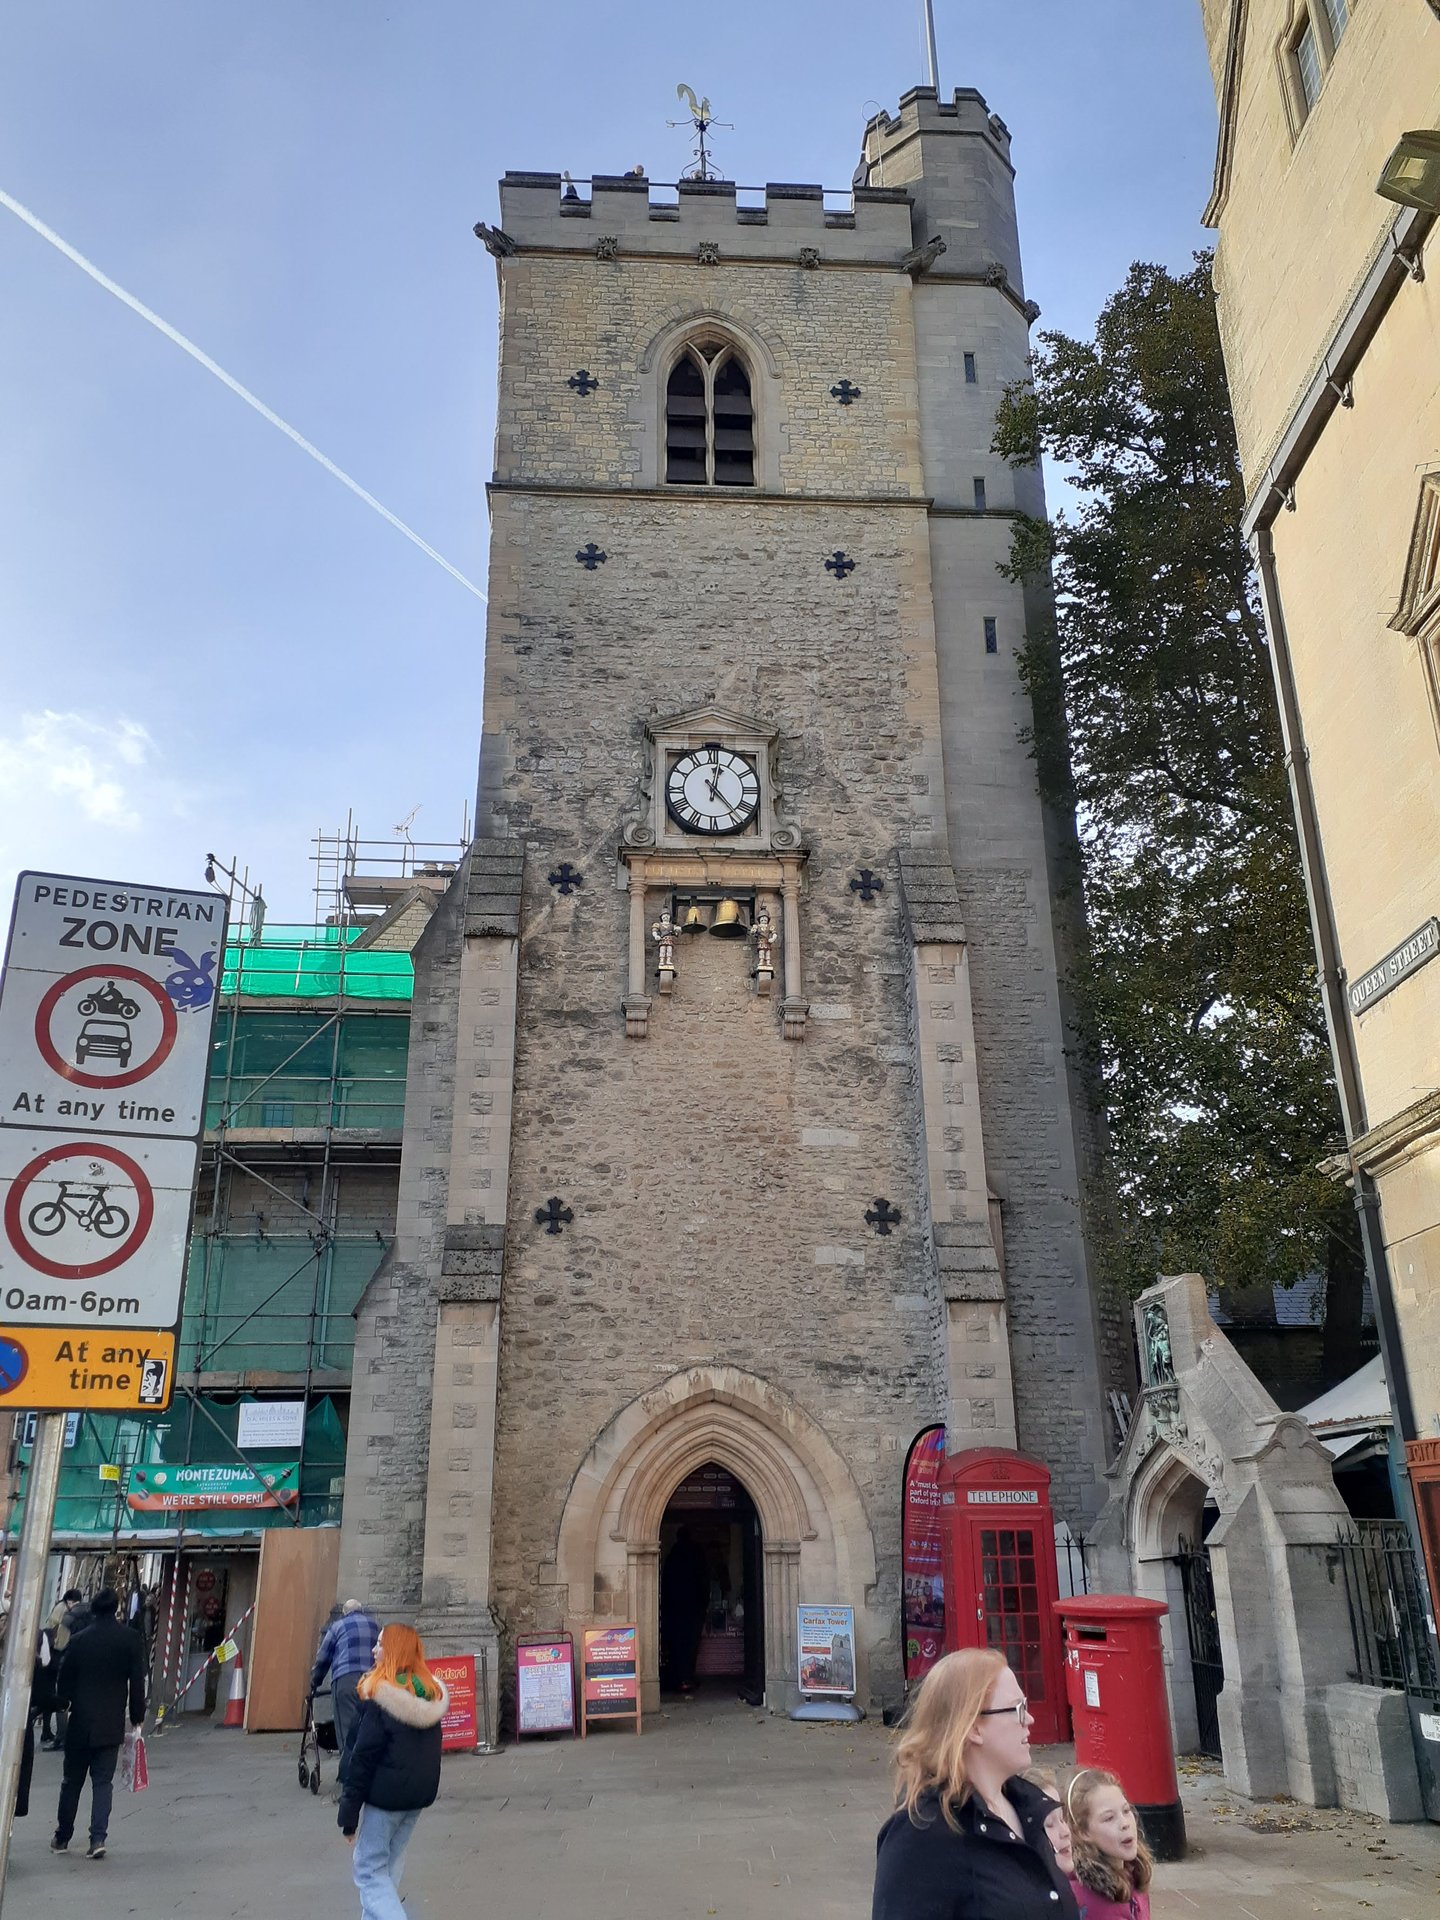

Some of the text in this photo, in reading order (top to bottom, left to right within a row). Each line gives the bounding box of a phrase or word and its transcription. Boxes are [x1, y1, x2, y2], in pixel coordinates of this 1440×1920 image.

[34, 885, 214, 922] PEDESTRIAN
[59, 917, 179, 957] ZONE
[1351, 927, 1434, 1008] QUEEN STREET
[12, 1092, 176, 1122] At any time
[55, 1340, 151, 1368] At any
[69, 1368, 131, 1390] time
[1412, 1442, 1437, 1462] CITY
[175, 1467, 256, 1481] MONTEZUMA'S
[162, 1493, 263, 1506] WE'RE STILL OPEN!
[910, 1496, 929, 1505] Oxford
[969, 1491, 1035, 1503] TELEPHONE
[803, 1617, 848, 1626] Carfax Tower
[434, 1665, 467, 1680] Oxford
